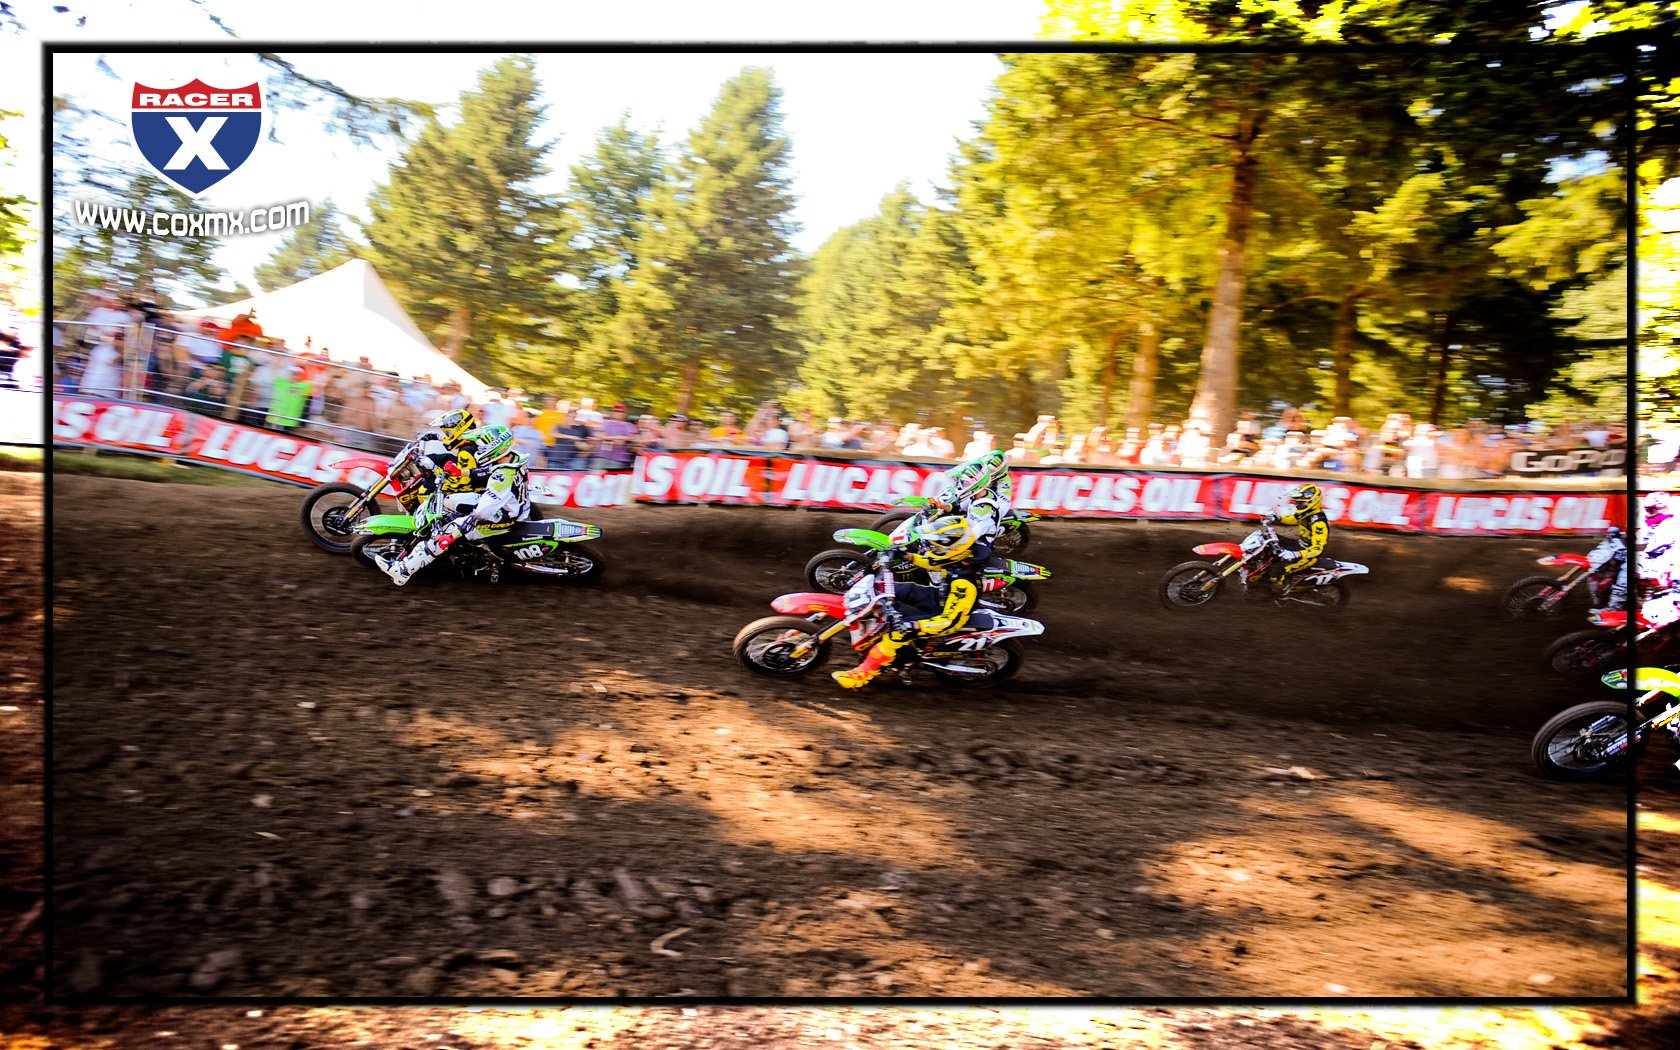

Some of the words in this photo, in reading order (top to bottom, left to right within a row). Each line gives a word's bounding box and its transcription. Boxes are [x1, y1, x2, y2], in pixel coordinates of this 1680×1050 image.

[95, 405, 175, 447] OIL
[199, 424, 352, 483] LUCAS
[682, 456, 751, 497] OIL
[782, 463, 919, 504] LUCAS
[1014, 474, 1143, 512] LUCAS
[1141, 475, 1205, 513] OIL
[1349, 490, 1410, 525] OIL
[1432, 497, 1554, 530] LUCAS
[1550, 497, 1611, 530] OIL
[513, 544, 544, 560] 108
[958, 638, 989, 651] 21
